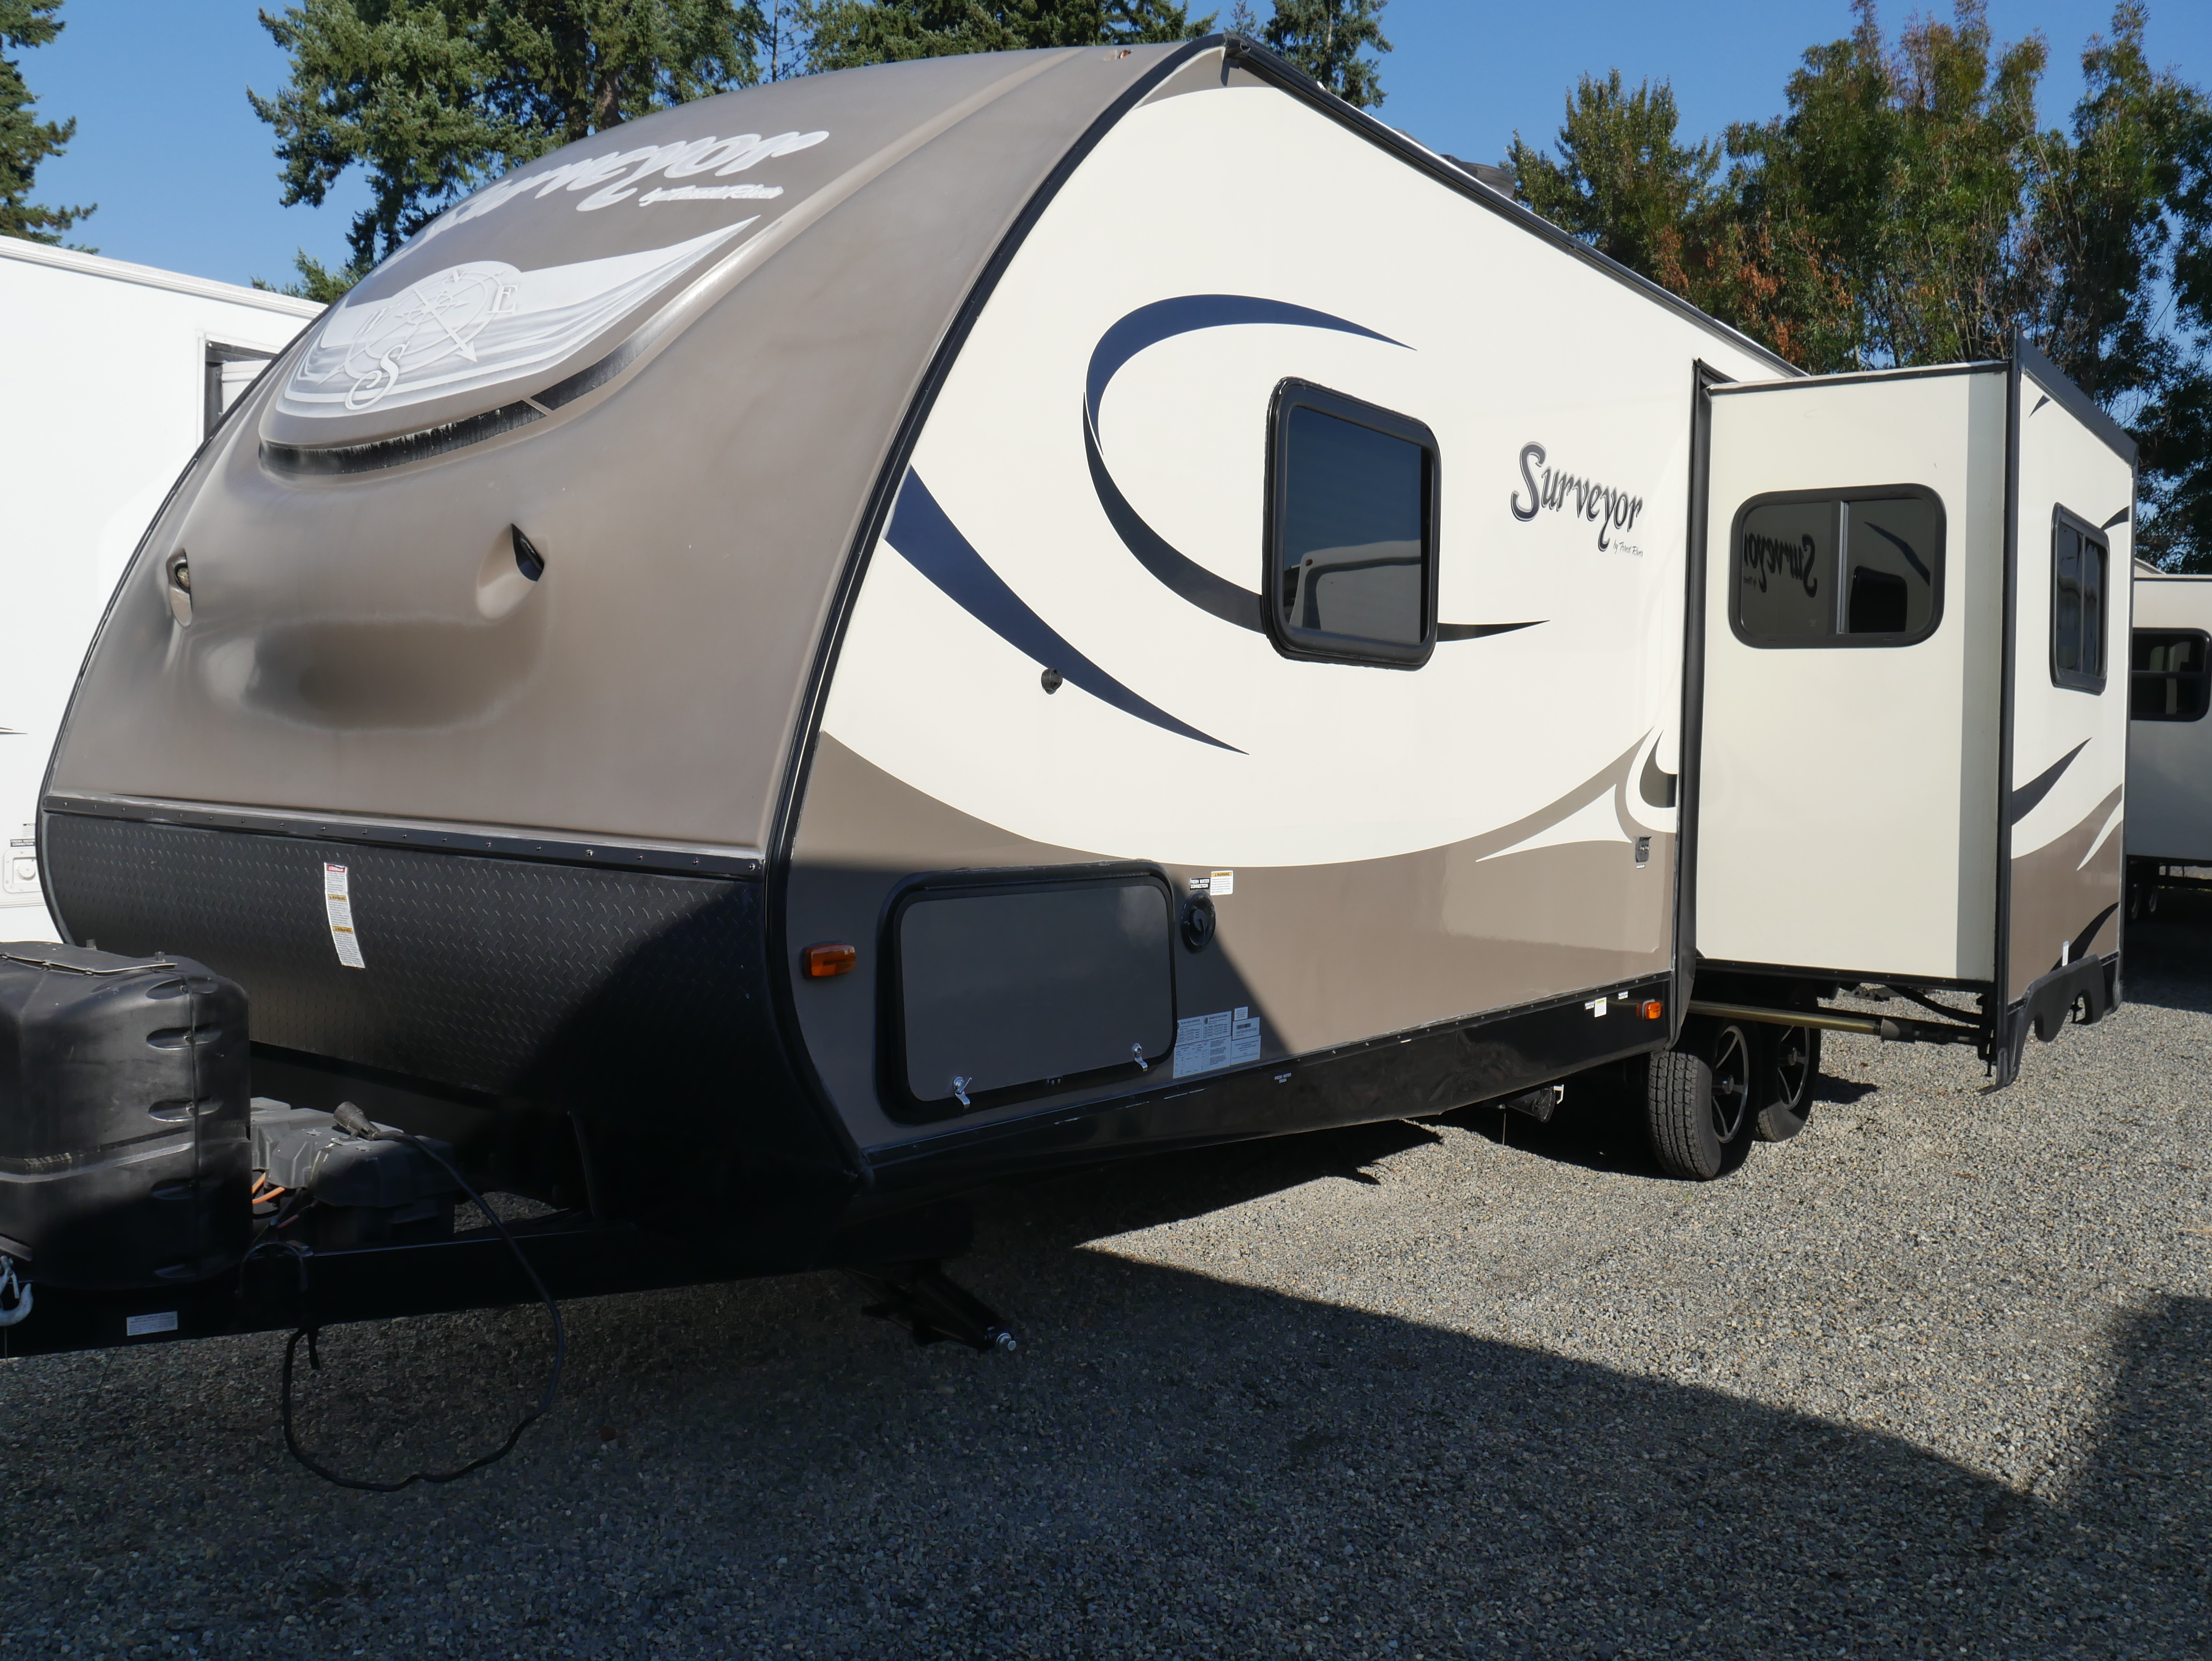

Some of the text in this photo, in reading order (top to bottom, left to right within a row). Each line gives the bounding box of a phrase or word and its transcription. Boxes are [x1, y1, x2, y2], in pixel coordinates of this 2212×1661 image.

[487, 283, 519, 315] E
[345, 341, 410, 410] S
[1511, 441, 1643, 552] Surveyor
[1613, 540, 1619, 554] by
